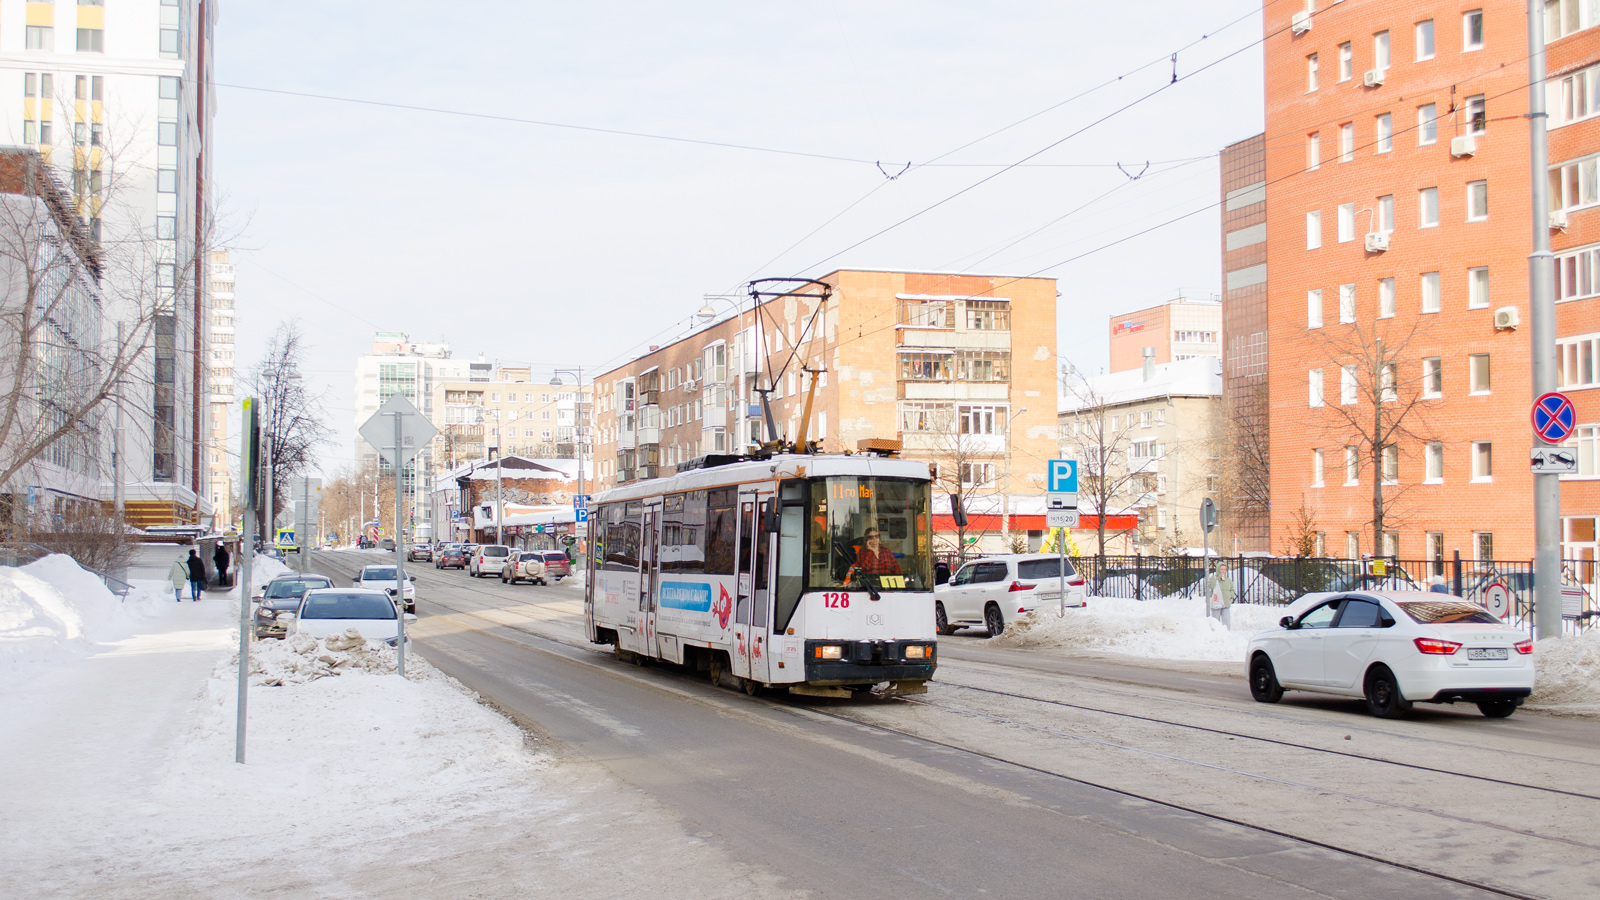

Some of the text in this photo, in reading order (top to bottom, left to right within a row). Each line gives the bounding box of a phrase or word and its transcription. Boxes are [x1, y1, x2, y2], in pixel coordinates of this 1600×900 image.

[1053, 462, 1072, 490] P
[859, 484, 874, 498] Мая
[579, 510, 587, 521] P
[884, 578, 898, 588] 11
[823, 592, 850, 608] 128
[1494, 594, 1500, 608] 5
